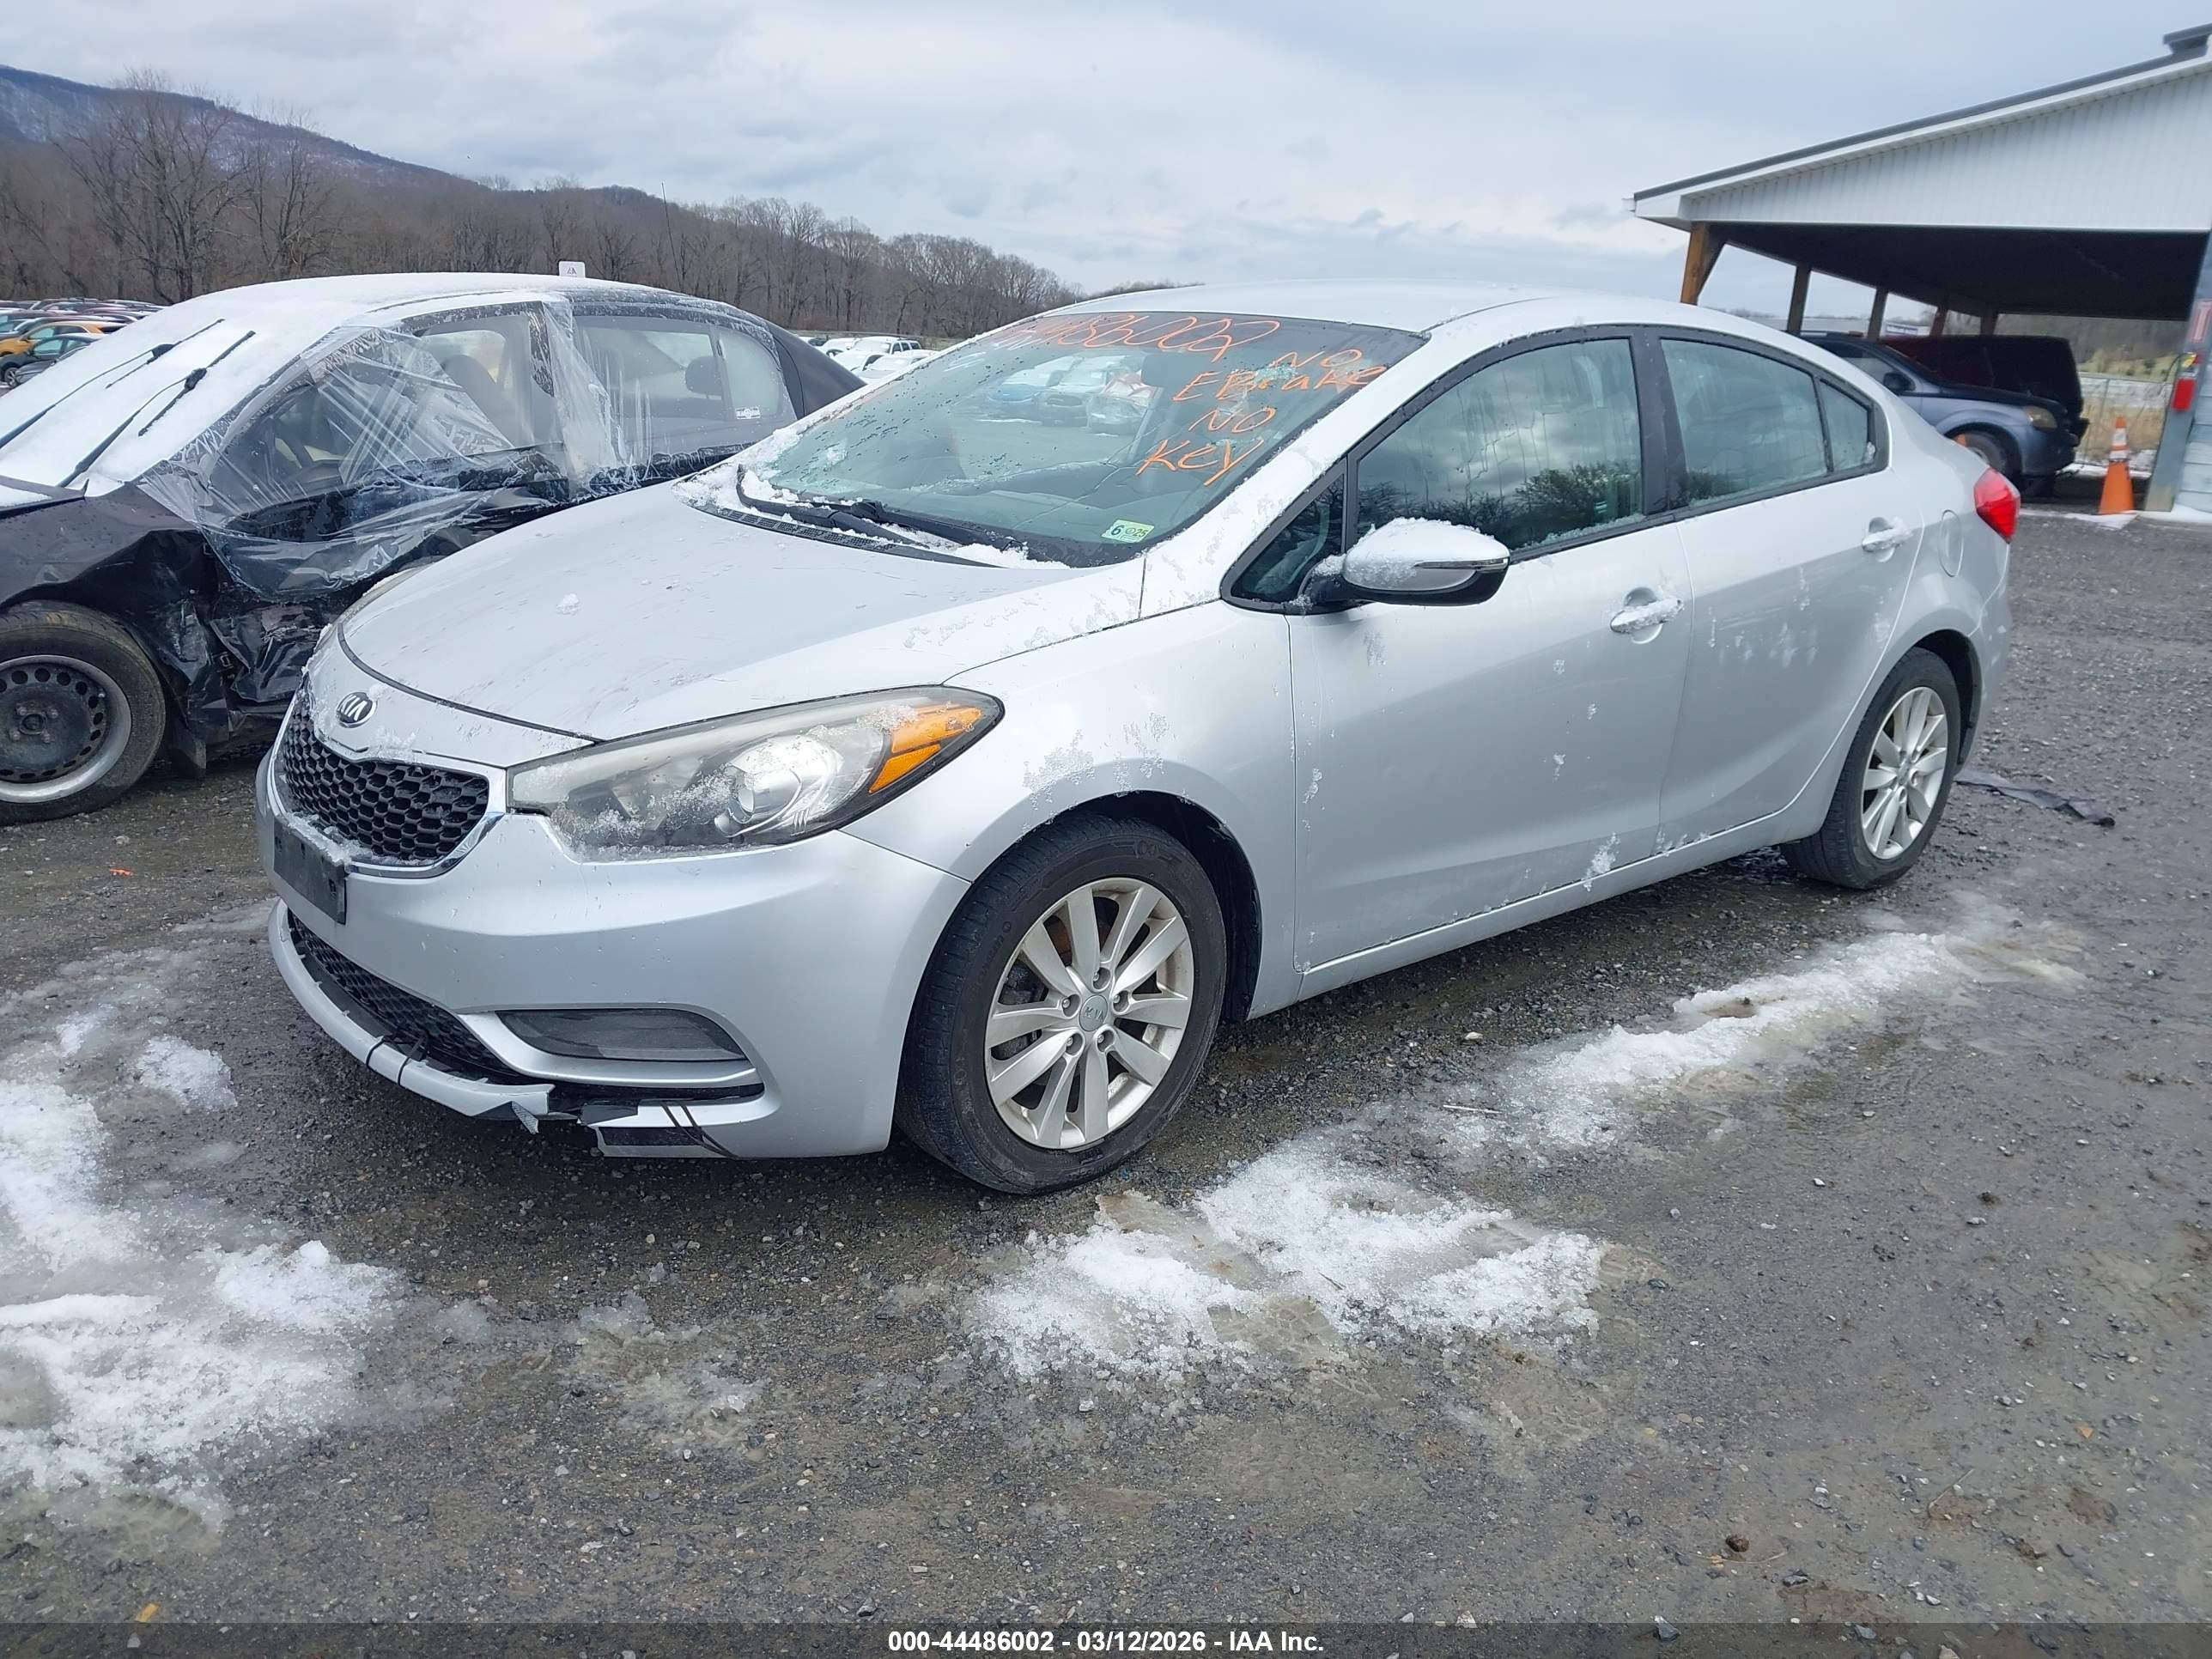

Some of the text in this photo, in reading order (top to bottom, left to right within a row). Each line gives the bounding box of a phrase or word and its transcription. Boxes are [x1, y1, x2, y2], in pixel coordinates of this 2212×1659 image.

[1267, 349, 1364, 369] NO
[1188, 407, 1277, 434] NO
[1110, 525, 1149, 538] 6 25
[337, 694, 368, 721] KIA
